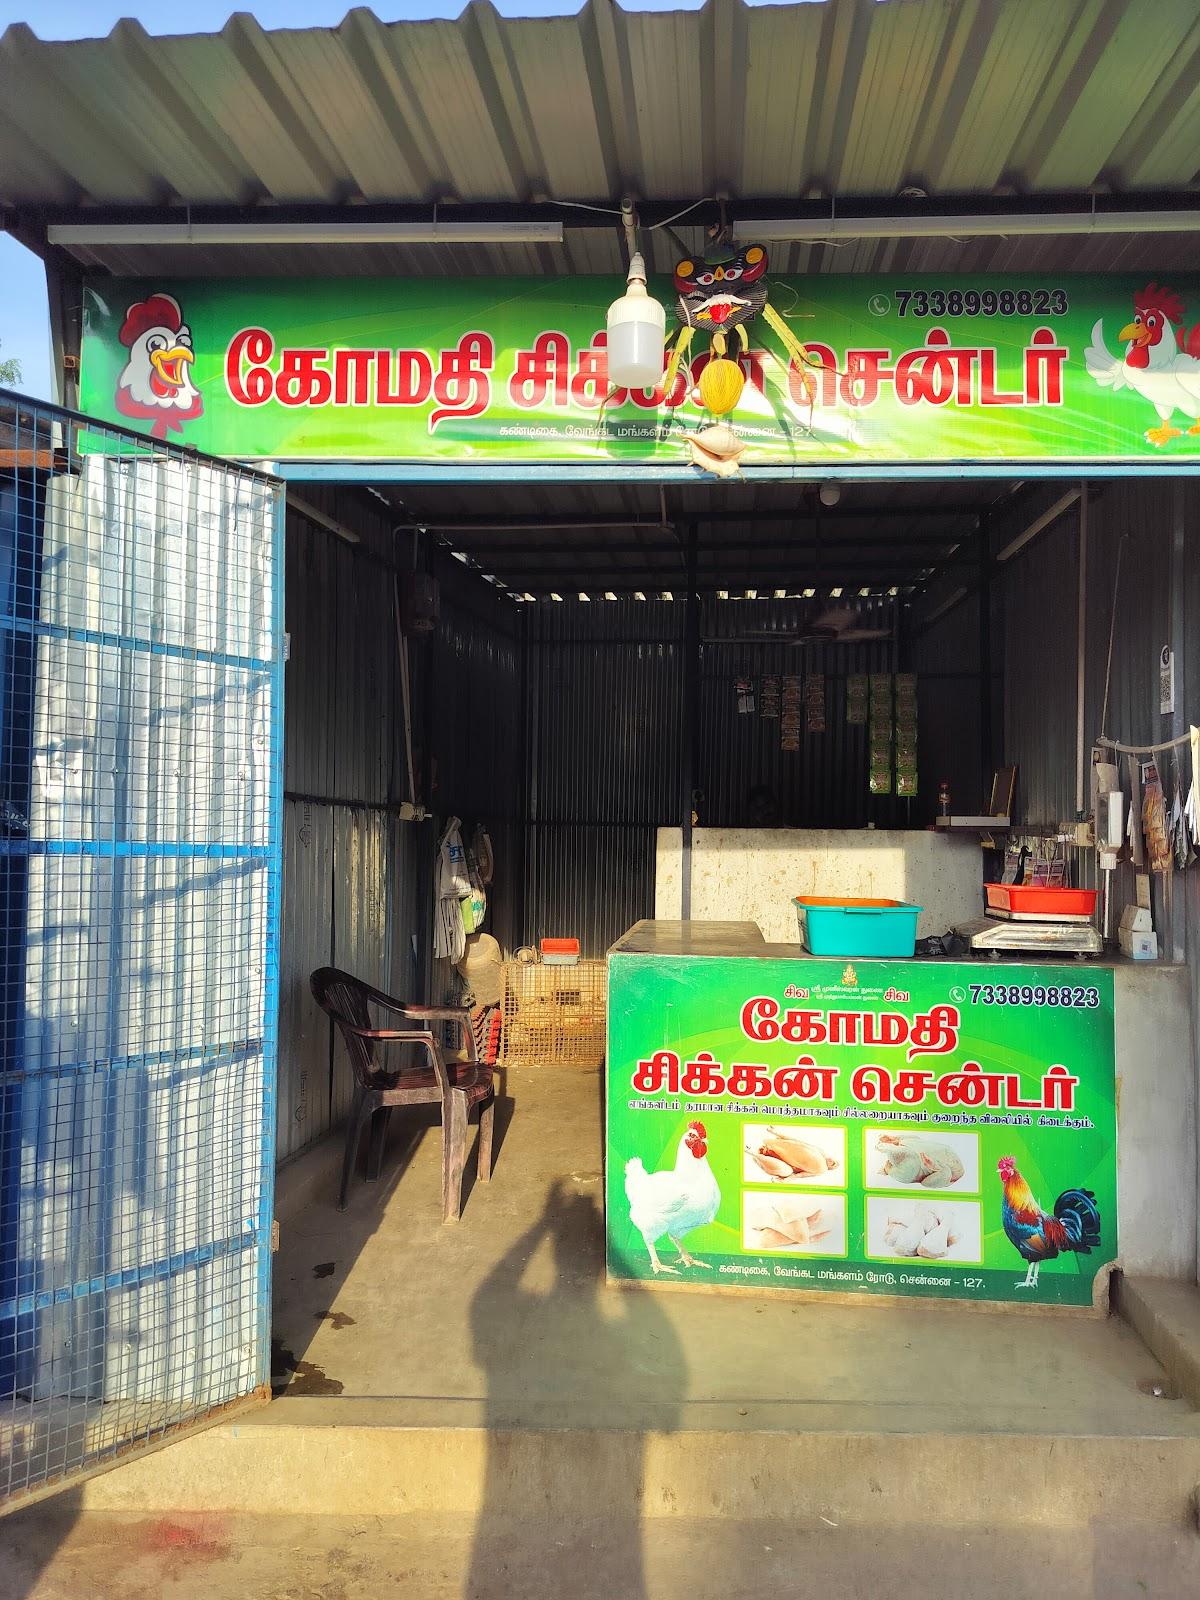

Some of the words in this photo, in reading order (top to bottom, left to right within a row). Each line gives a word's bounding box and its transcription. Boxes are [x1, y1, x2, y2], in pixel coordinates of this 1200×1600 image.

[895, 290, 1069, 316] 7338998823
[223, 326, 495, 436] கோமதி
[789, 326, 1069, 407] சென்டர்
[784, 984, 809, 999] சிவ
[884, 987, 910, 1002] சிவ
[969, 984, 1099, 1008] 7338998823
[739, 996, 960, 1062] கோமதி
[631, 1050, 839, 1100] சிக்கன்
[851, 1061, 1079, 1110] சென்டர்
[628, 1098, 681, 1111] எங்களிடம்
[685, 1101, 723, 1113] தரமான
[726, 1102, 759, 1114] சிக்கன்
[761, 1104, 840, 1119] மொத்தமாகவும்
[843, 1106, 929, 1122] சில்லறையாகவும்
[932, 1111, 977, 1125] குறைந்த
[719, 1263, 771, 1277] கண்டிகை,
[774, 1266, 814, 1279] வேங்கட
[817, 1267, 863, 1281] மங்களம்
[866, 1272, 897, 1285] ரோடு,
[900, 1274, 950, 1287] சென்னை
[963, 1278, 986, 1288] 127.
